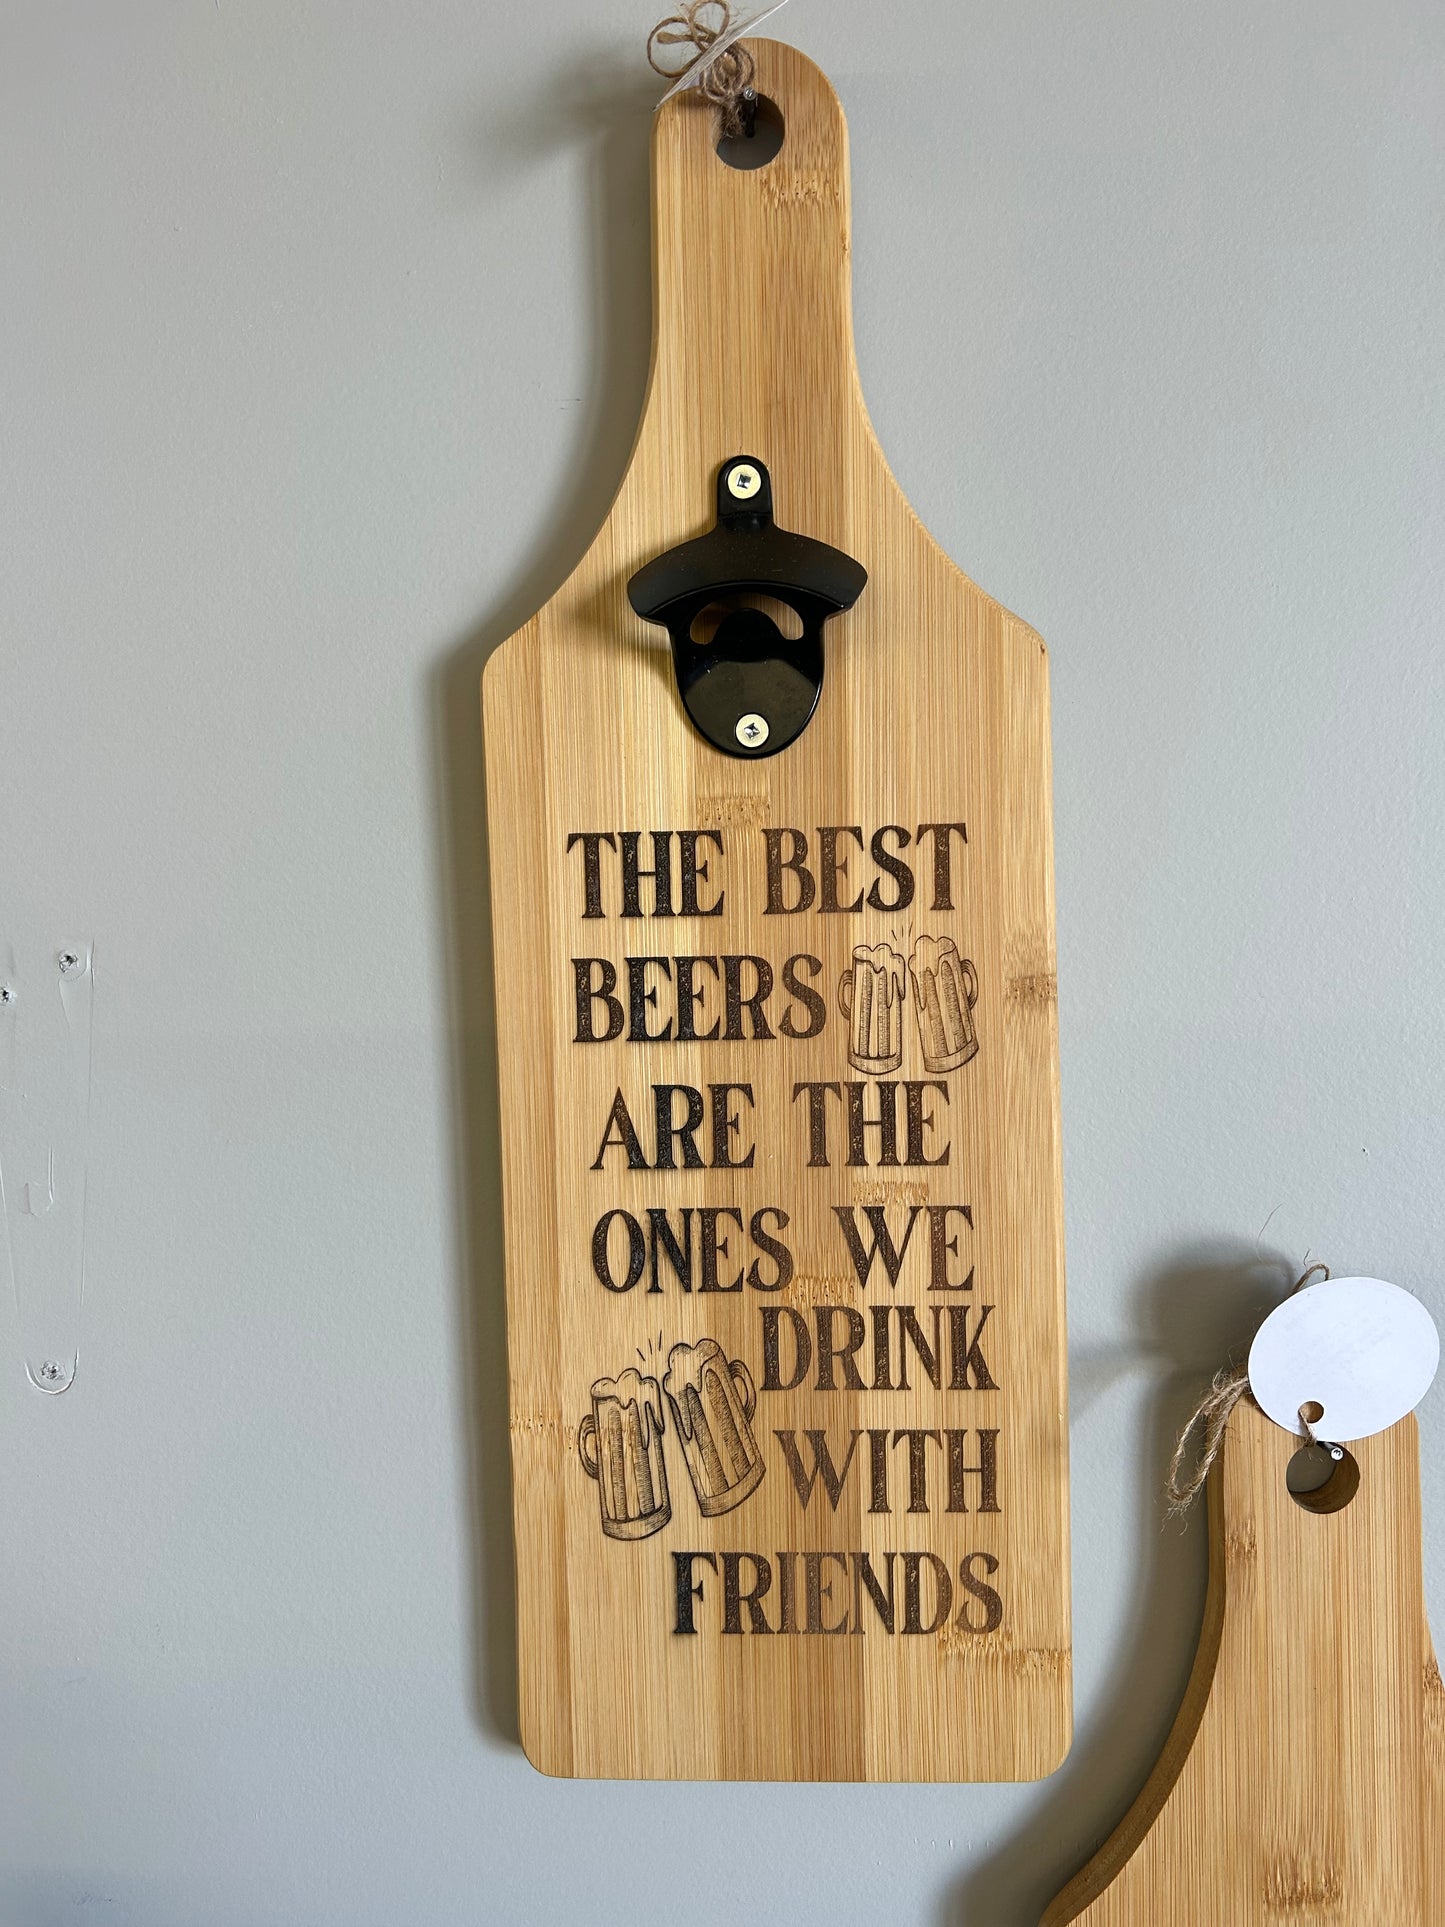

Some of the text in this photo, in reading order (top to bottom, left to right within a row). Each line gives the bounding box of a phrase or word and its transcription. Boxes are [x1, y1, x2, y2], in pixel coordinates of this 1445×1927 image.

[566, 823, 968, 918] THE BEST
[571, 953, 827, 1043] BEERS
[590, 1080, 951, 1170] ARE THE
[591, 1205, 975, 1294] ONES WE
[759, 1305, 1001, 1391] DRINK
[772, 1429, 1002, 1514] WITH
[671, 1551, 1003, 1636] FRIENDS
